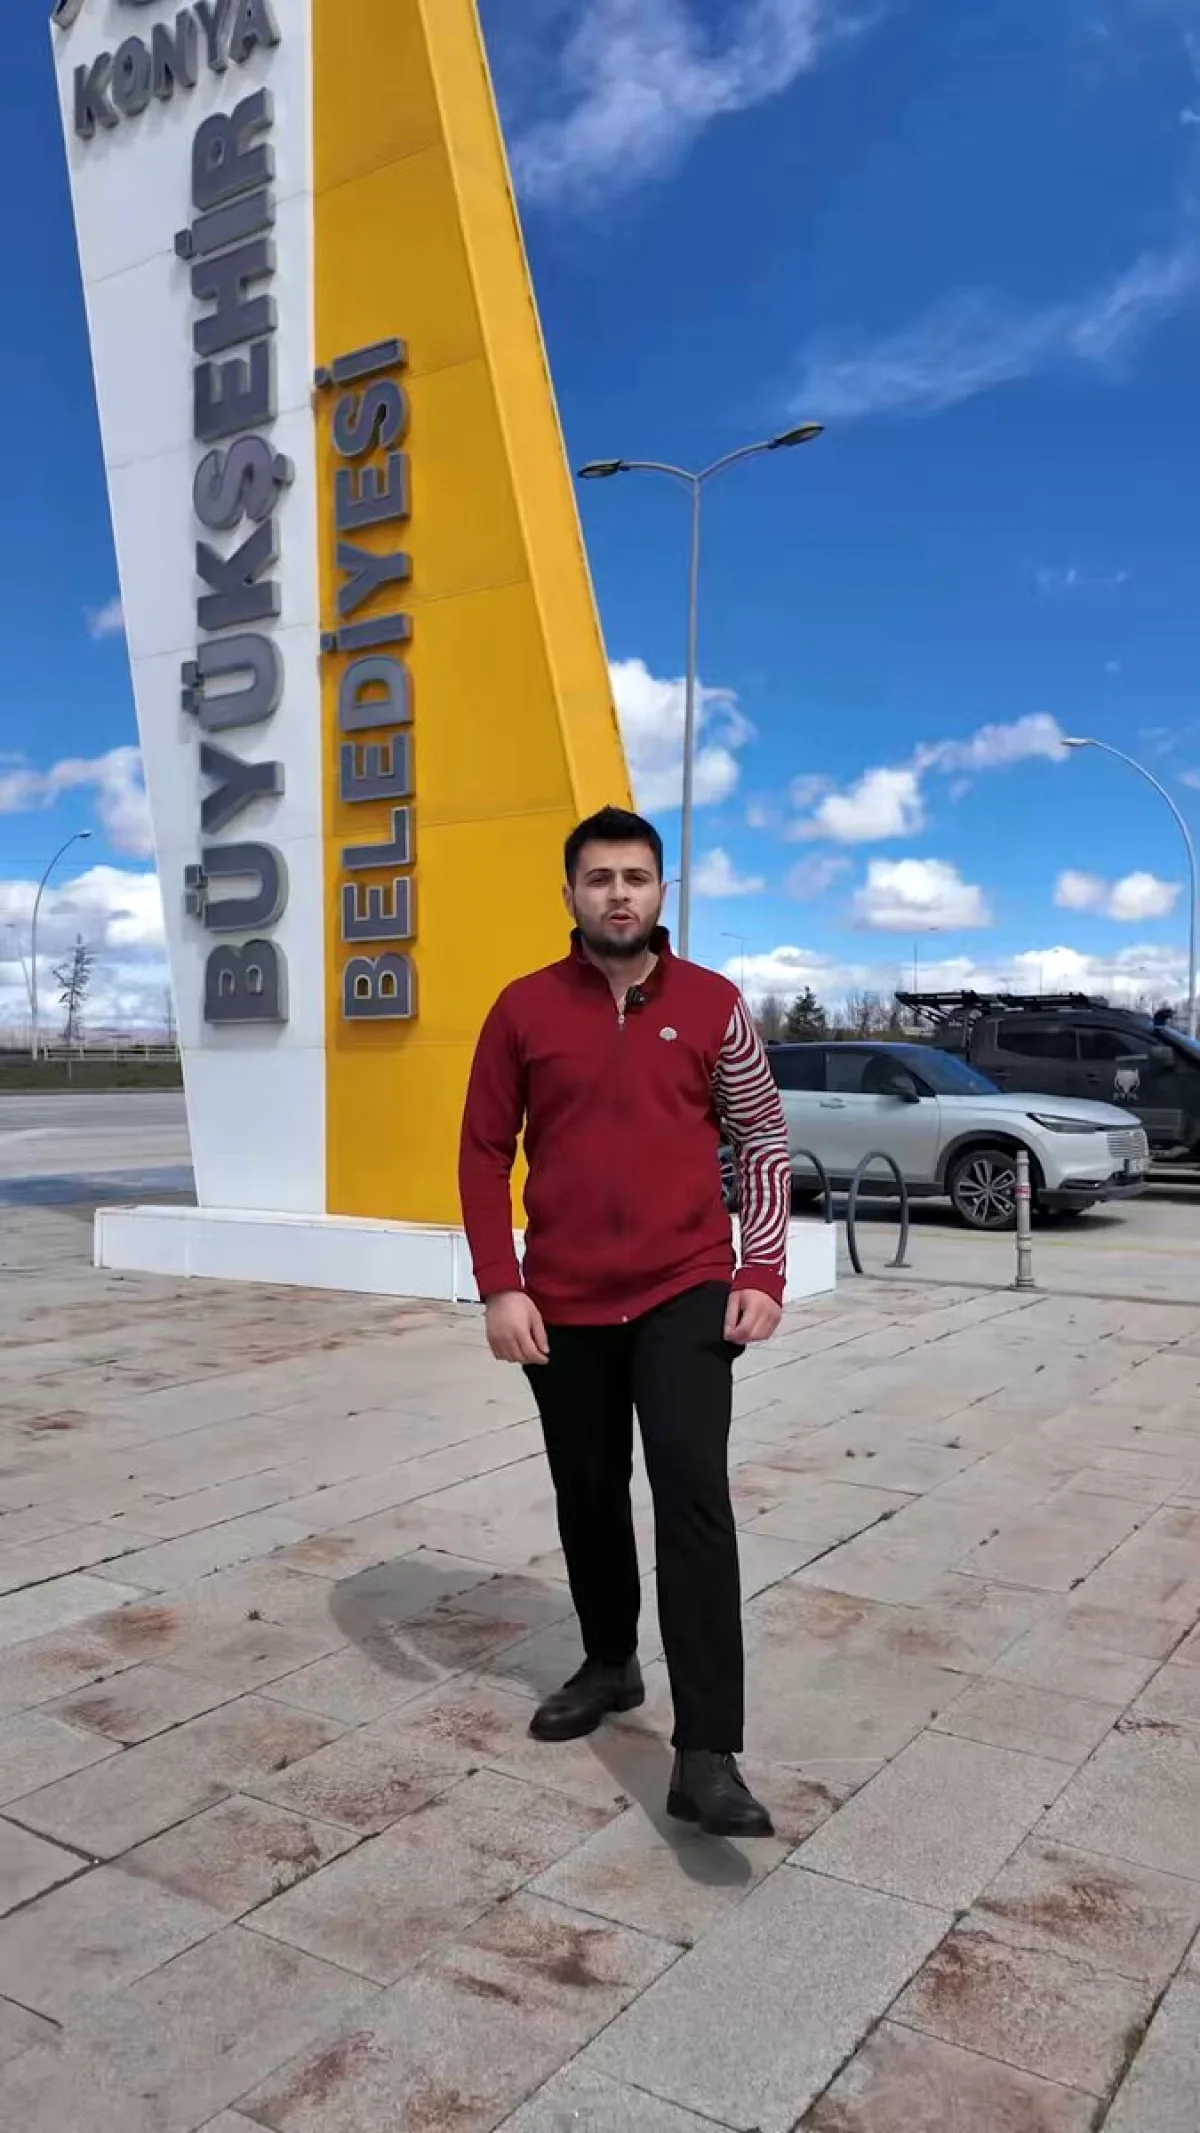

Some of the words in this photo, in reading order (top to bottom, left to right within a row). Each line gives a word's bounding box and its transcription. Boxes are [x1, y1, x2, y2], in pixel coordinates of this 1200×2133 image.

[73, 0, 281, 141] KONYA
[174, 86, 294, 1026] BÜYÜKŞEHİR
[313, 336, 417, 1022] BELEDİYESİ
